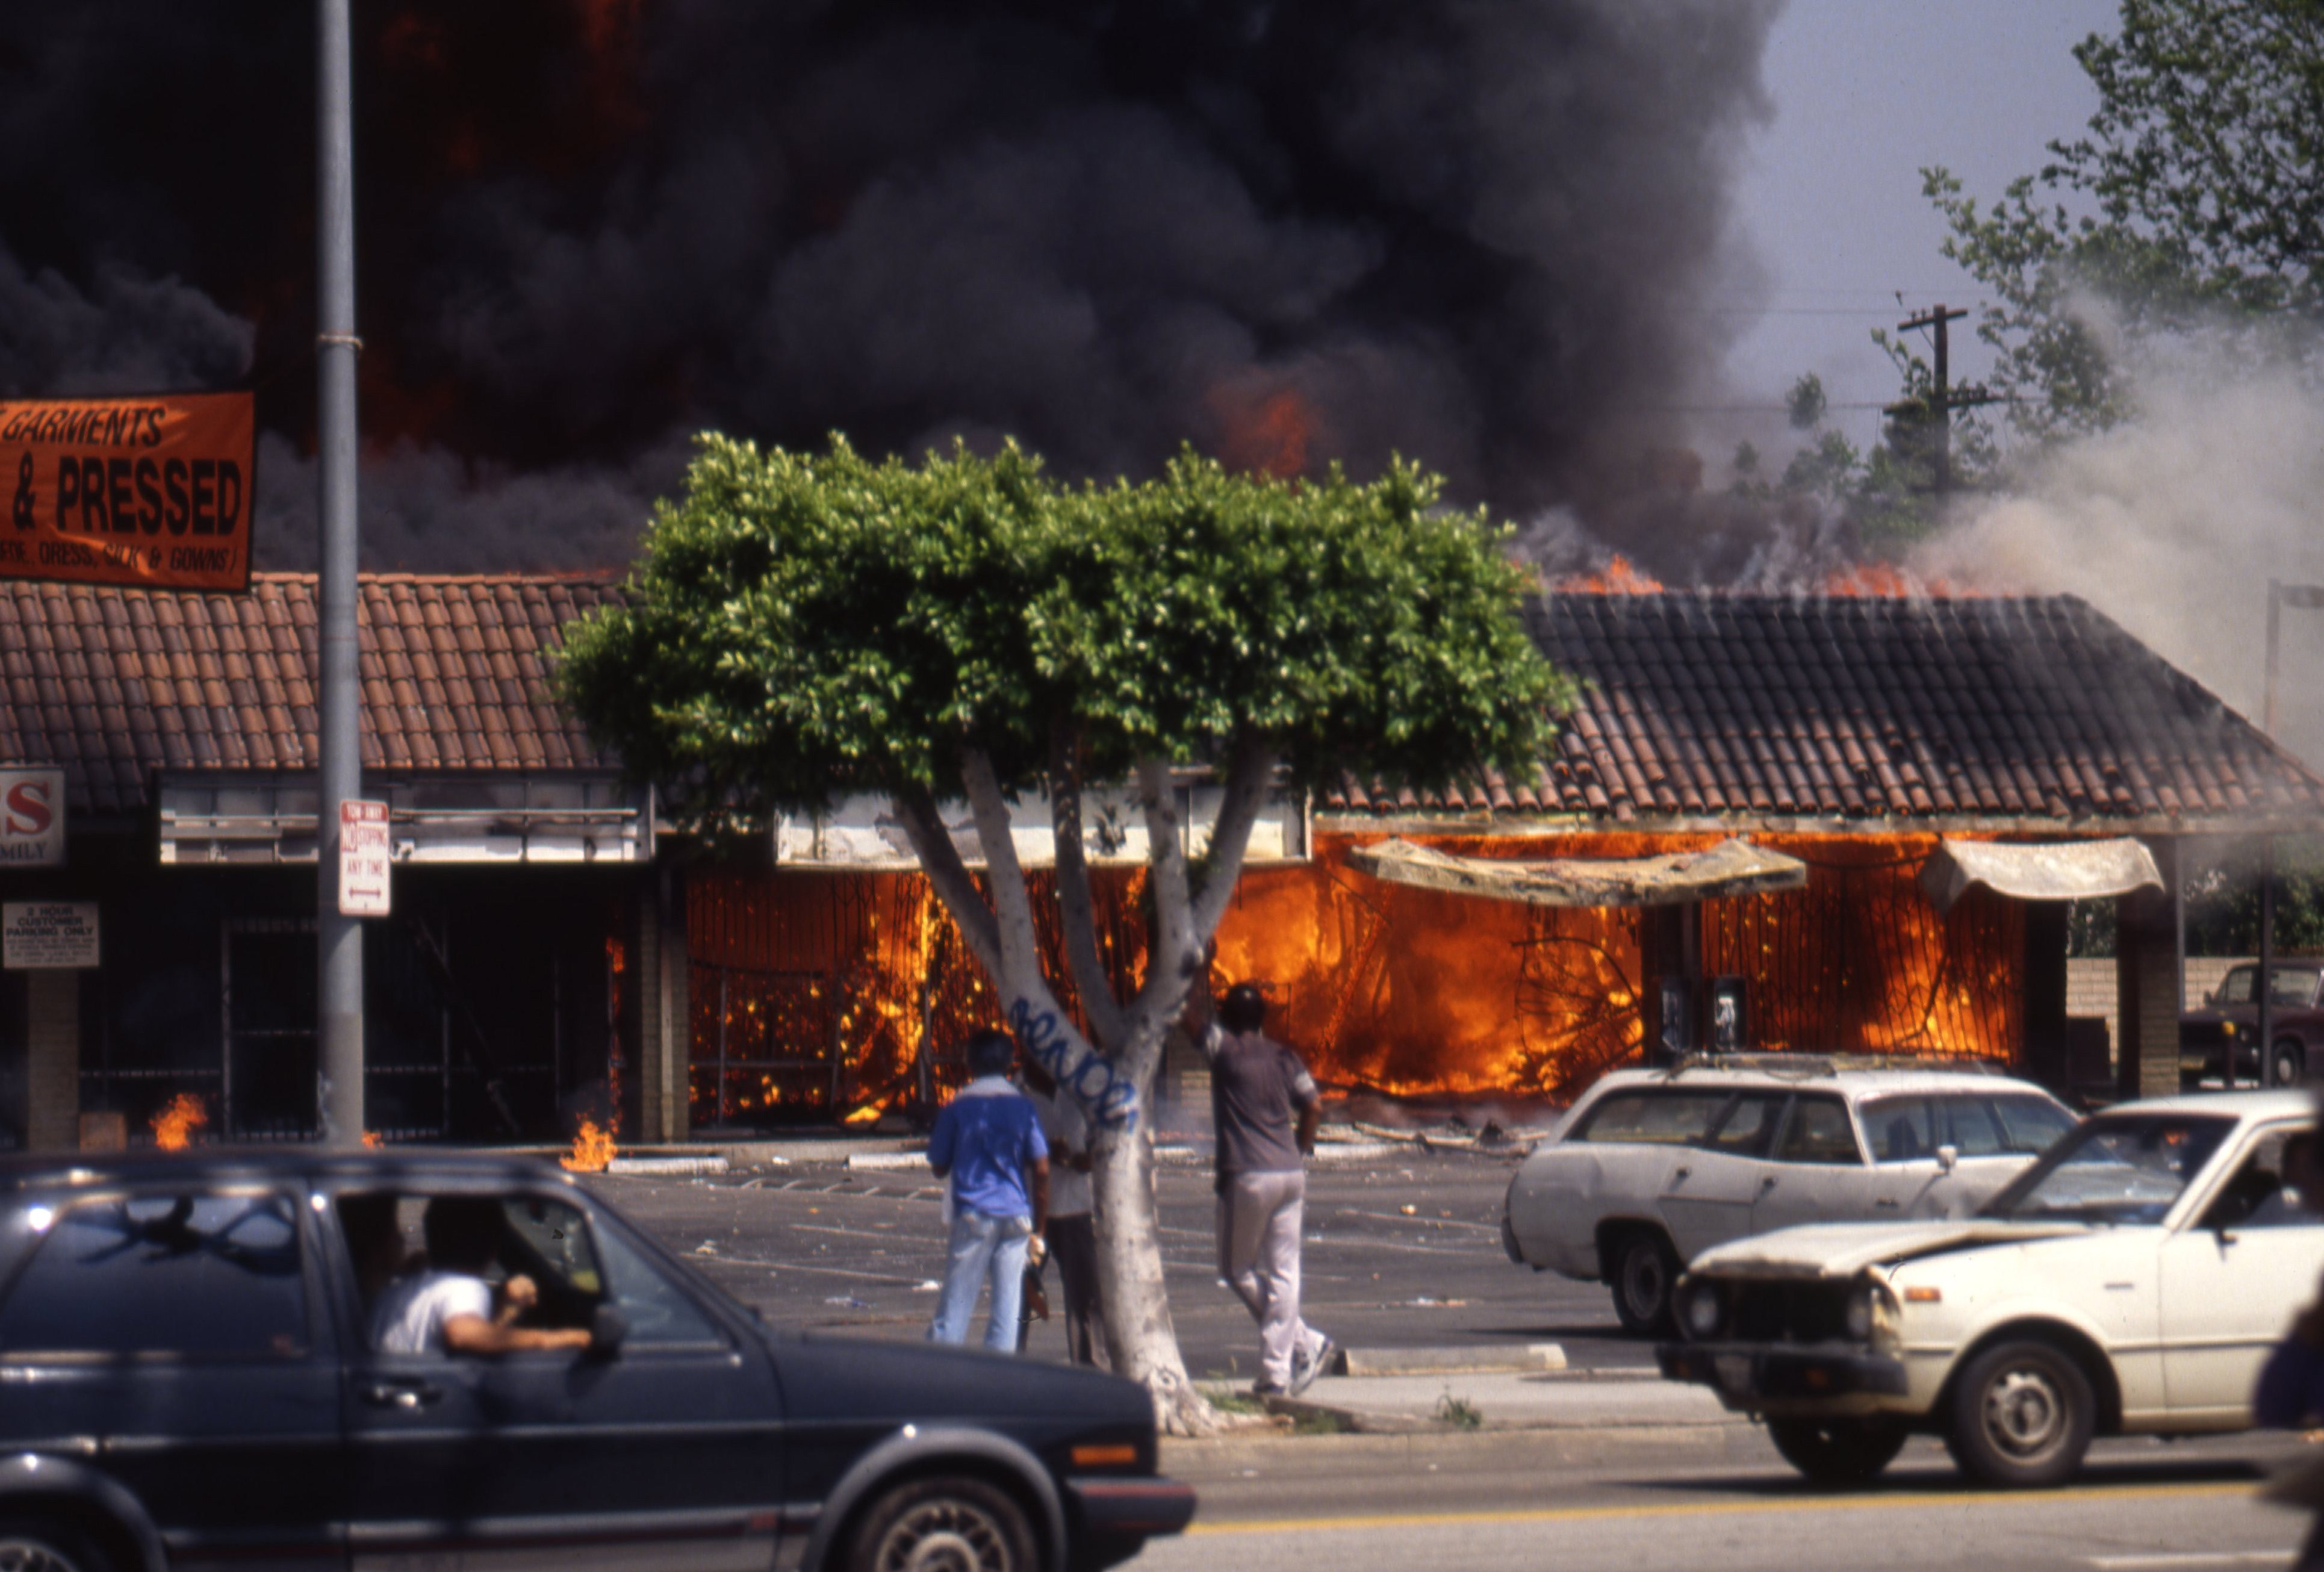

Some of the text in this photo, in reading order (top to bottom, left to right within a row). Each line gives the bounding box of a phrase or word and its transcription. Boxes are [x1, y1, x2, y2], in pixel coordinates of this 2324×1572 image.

[2, 407, 166, 447] GARMENTS
[12, 452, 241, 536] & PRESSED
[148, 547, 162, 568] &
[343, 822, 357, 850] NO
[17, 916, 82, 926] CUSTOMER
